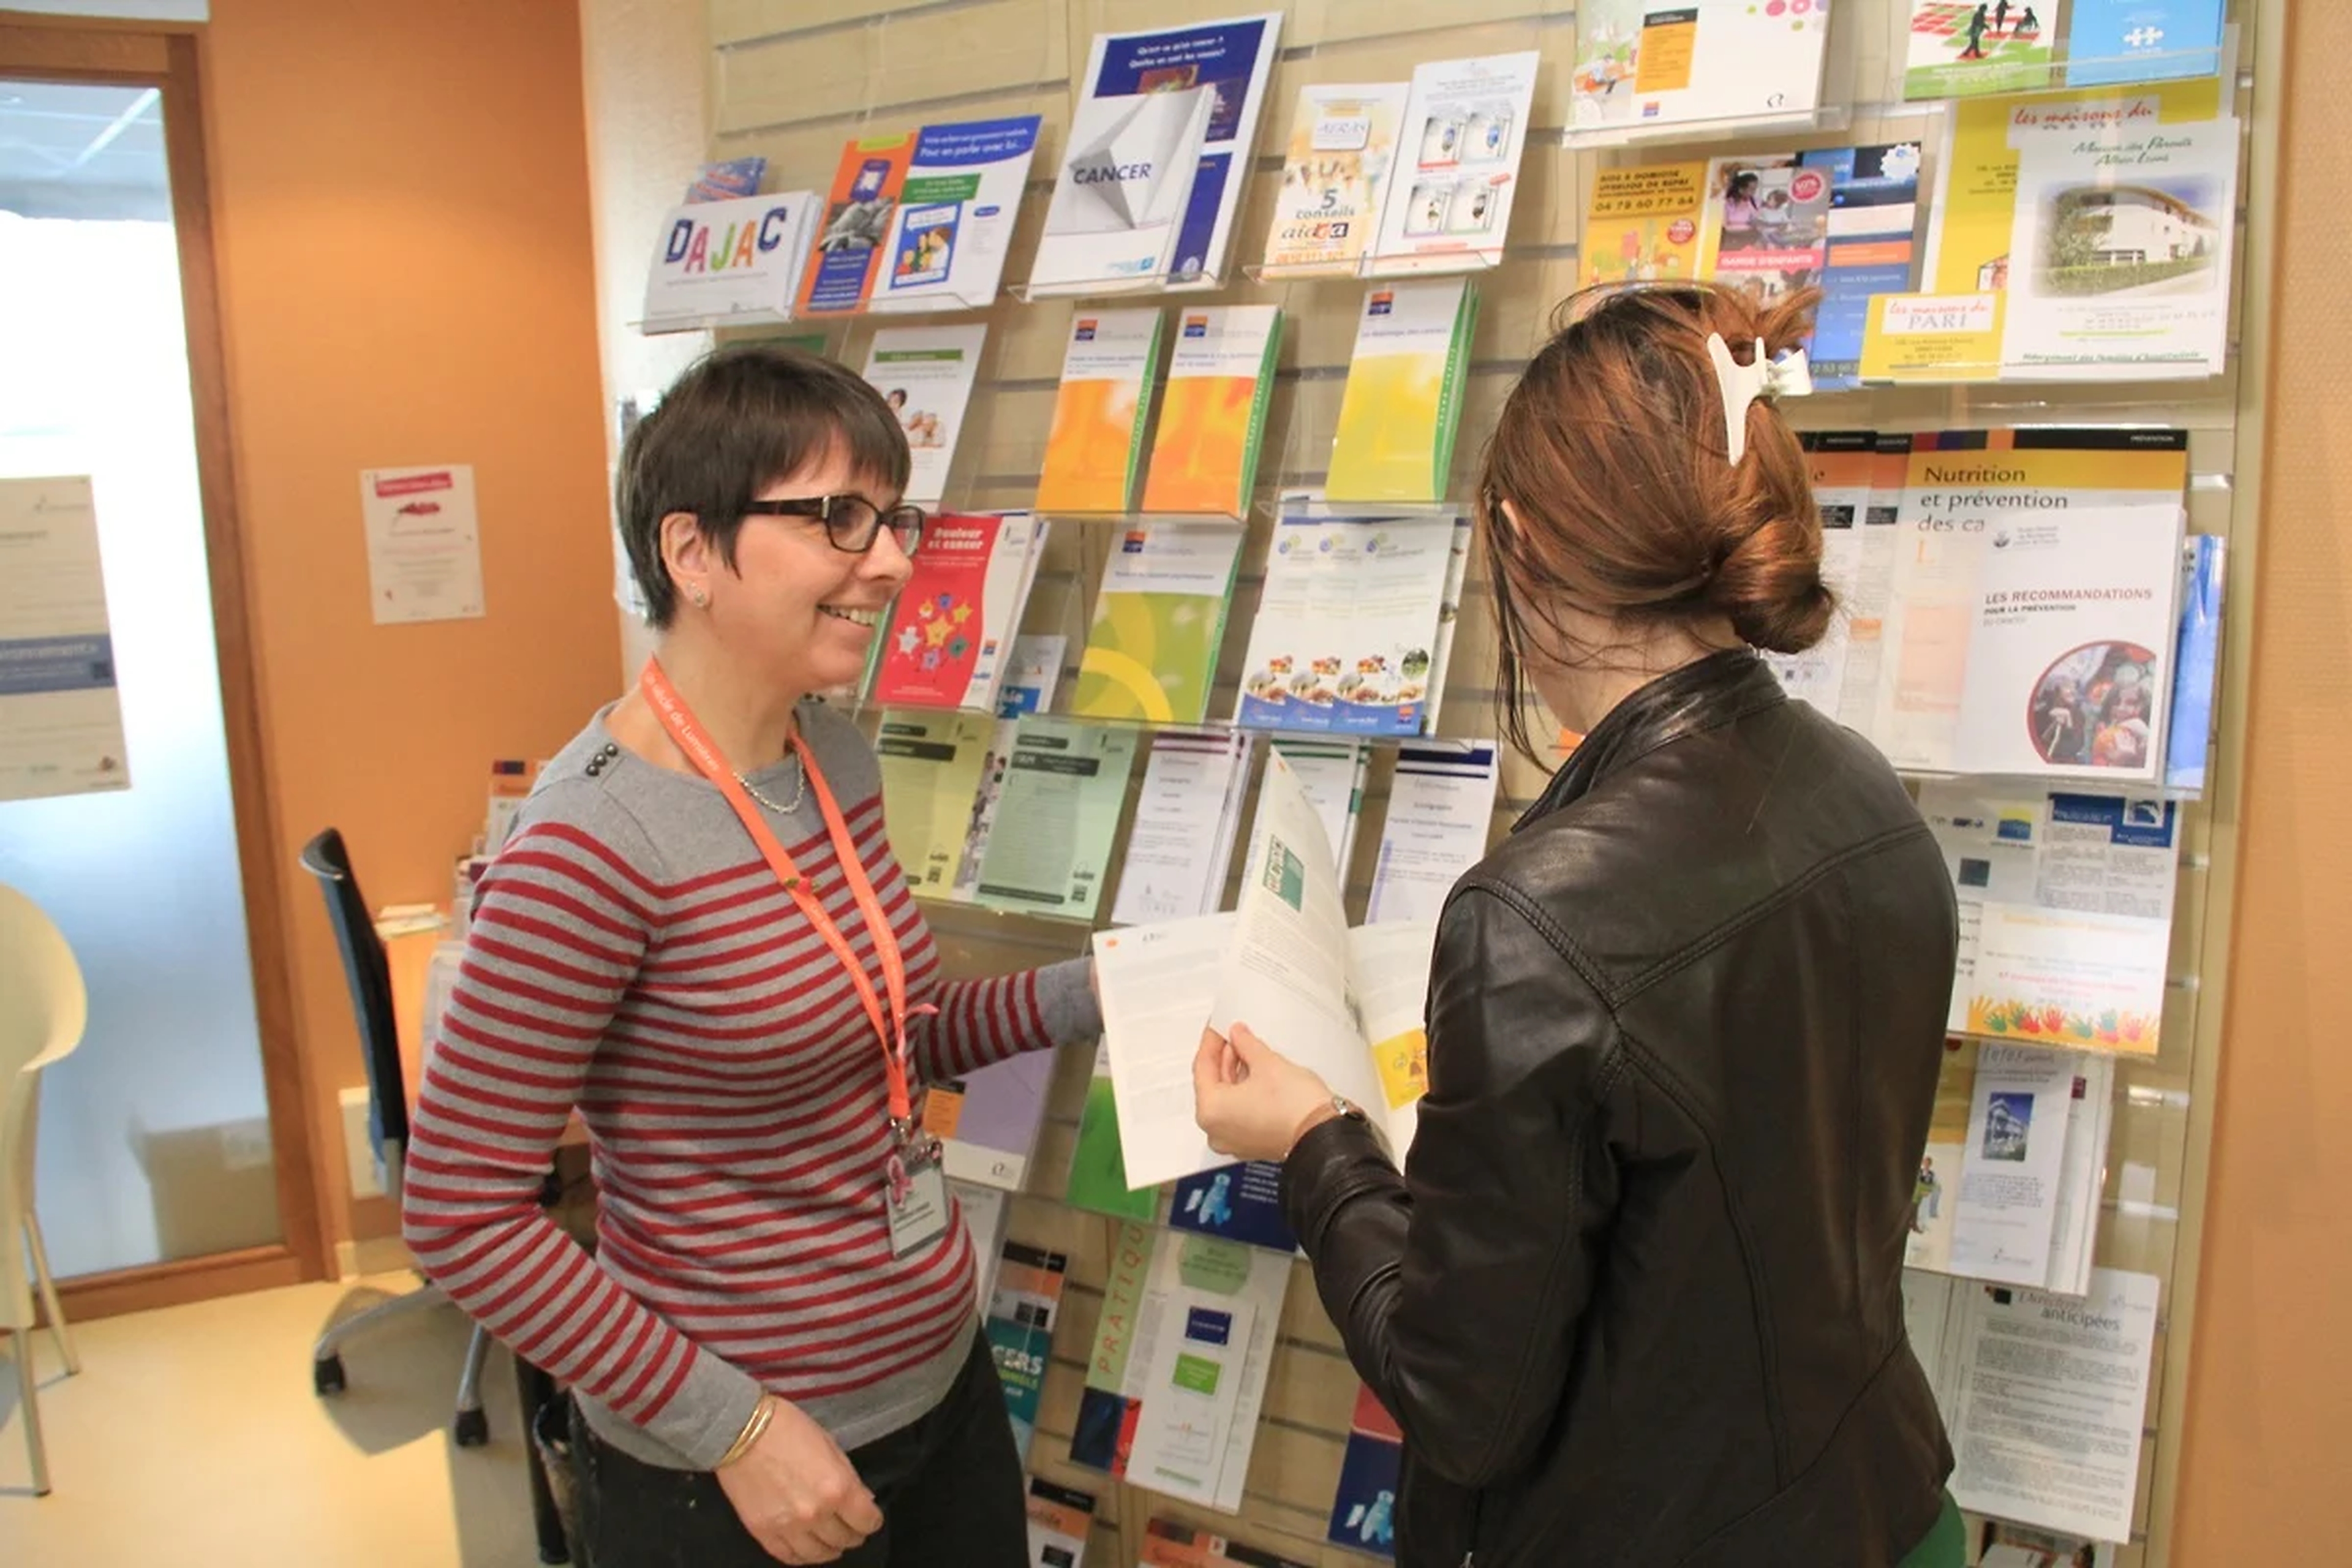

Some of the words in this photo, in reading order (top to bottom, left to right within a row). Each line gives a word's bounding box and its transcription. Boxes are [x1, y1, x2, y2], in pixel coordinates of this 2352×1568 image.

[1072, 163, 1152, 184] CANCER
[1321, 189, 1338, 209] 5
[1295, 205, 1355, 220] conseils
[665, 206, 788, 273] DAJAC
[1908, 313, 1967, 330] PARI
[1923, 466, 2026, 484] Nutrition
[1920, 493, 1943, 508] et
[1947, 490, 2068, 511] prévention
[1917, 514, 1956, 532] des
[1985, 592, 2008, 605] LES
[2011, 588, 2152, 603] RECOMMANDATIONS
[1983, 606, 2006, 616] POUR
[2040, 1306, 2122, 1332] anticipées
